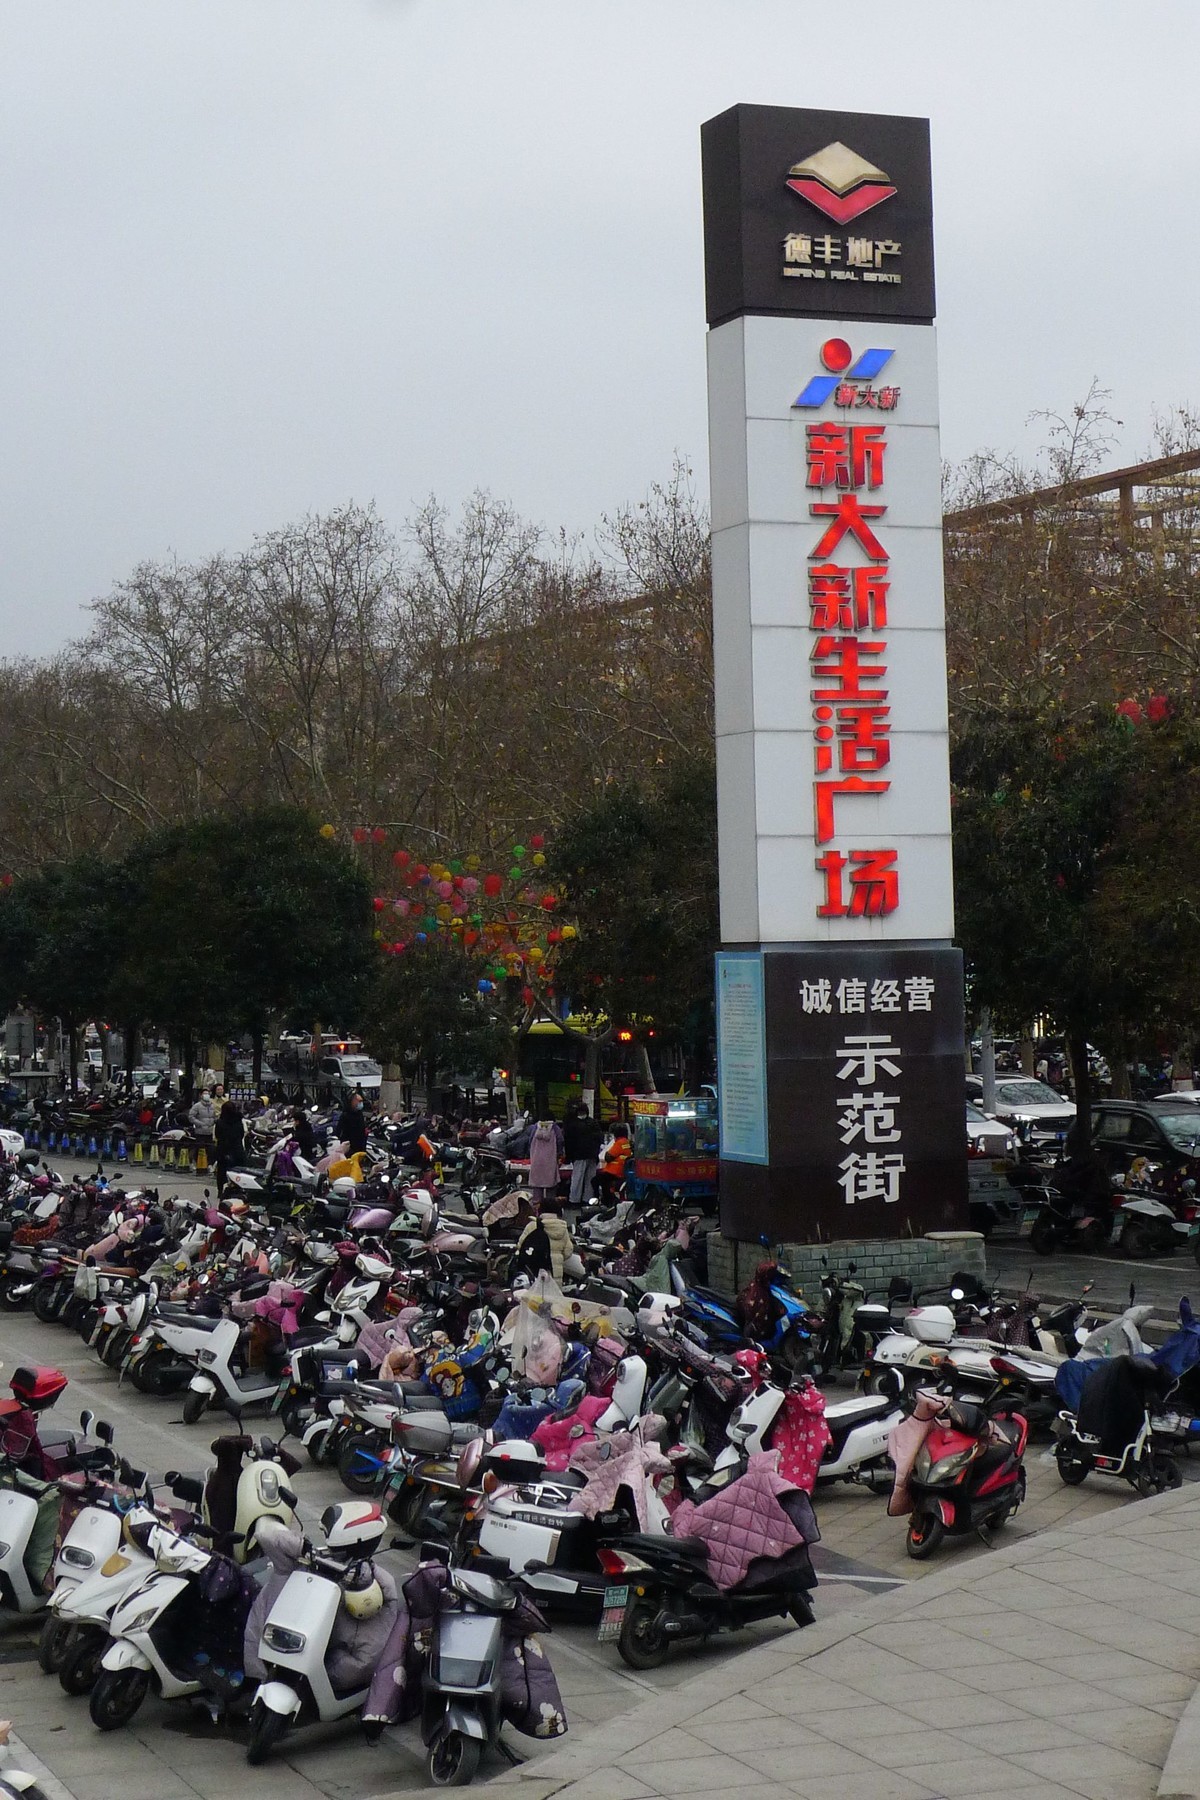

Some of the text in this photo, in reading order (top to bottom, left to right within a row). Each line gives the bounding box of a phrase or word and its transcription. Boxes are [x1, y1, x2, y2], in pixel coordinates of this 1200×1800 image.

[783, 232, 902, 268] 德丰地产
[830, 270, 859, 281] REAL
[863, 272, 902, 284] ESTATE
[834, 383, 901, 410] 新大新
[805, 422, 900, 918] 新大新生活广场
[799, 976, 936, 1015] 诚信经营
[835, 1034, 907, 1205] 示范街
